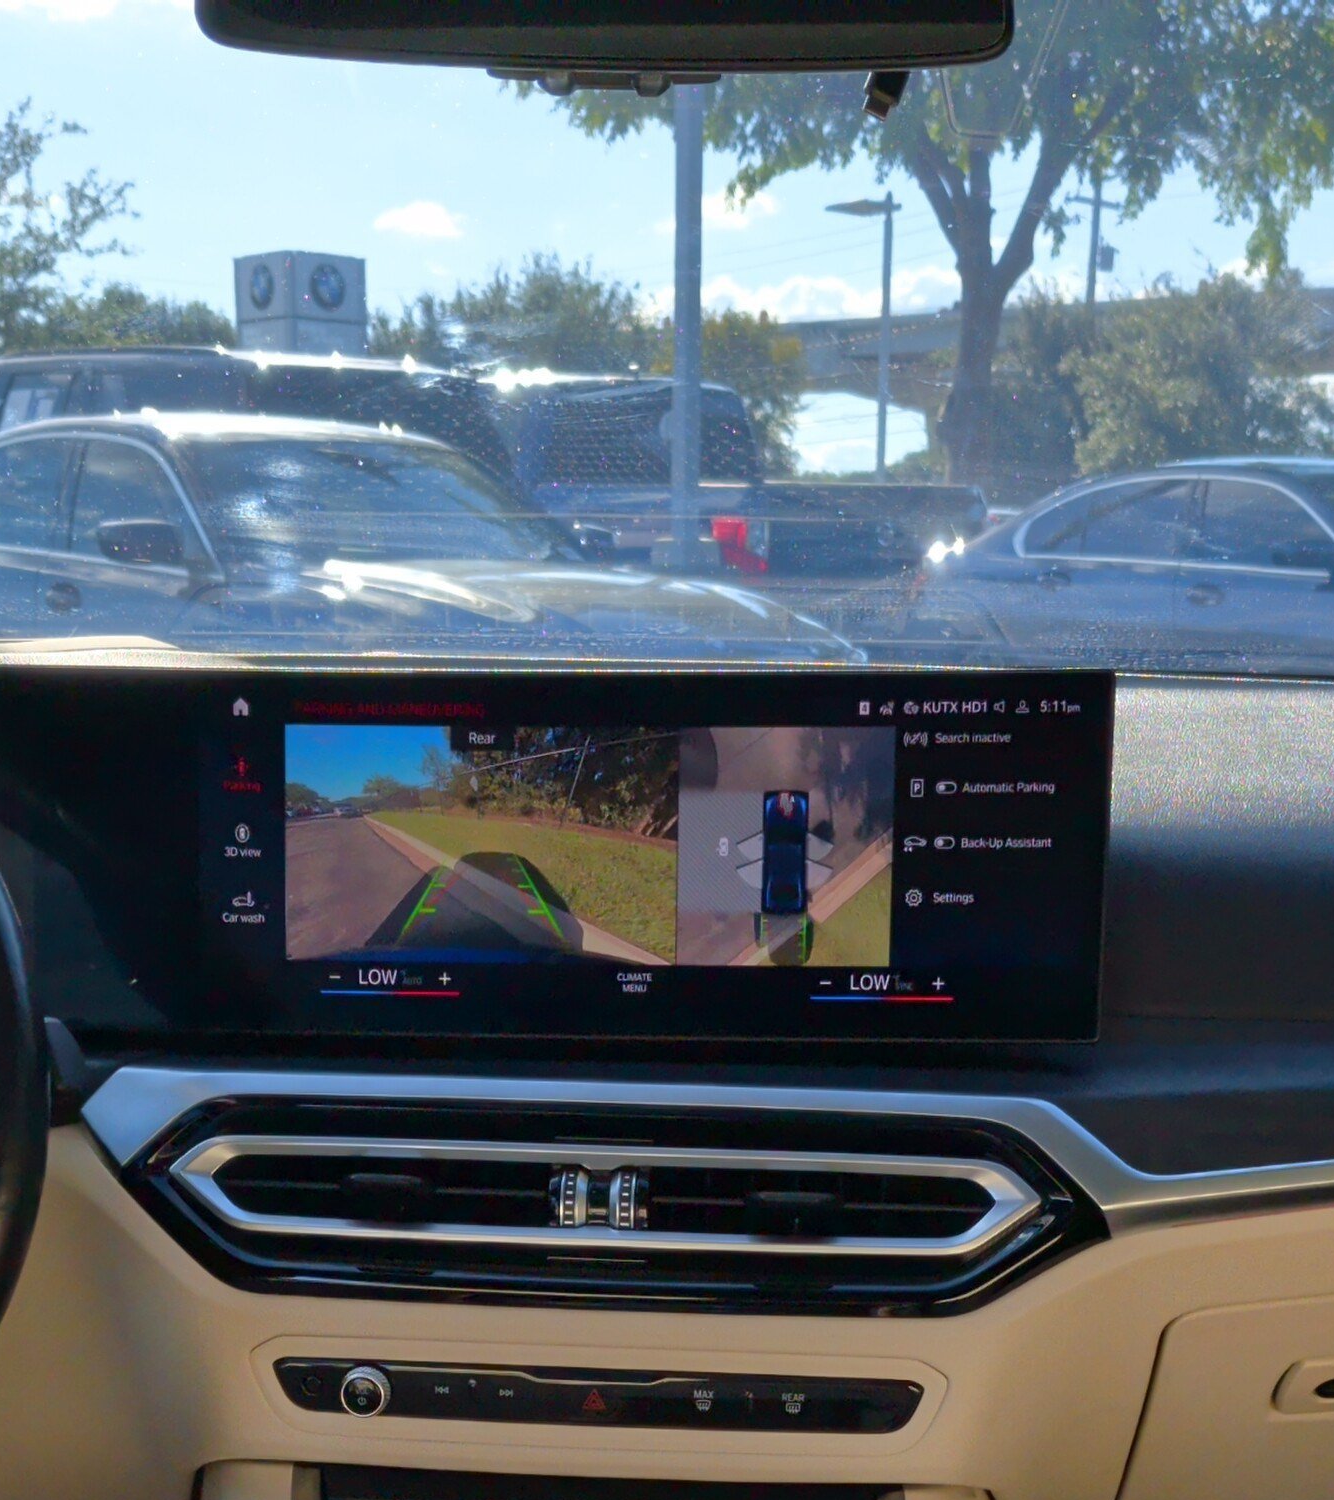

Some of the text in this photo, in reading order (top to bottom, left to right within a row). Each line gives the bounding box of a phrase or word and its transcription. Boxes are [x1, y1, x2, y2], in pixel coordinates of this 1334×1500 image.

[923, 701, 988, 713] KUTX HD1
[468, 731, 496, 745] Rear
[935, 732, 1012, 744] Search inactive
[962, 782, 1056, 795] Automatic Parking
[961, 837, 1052, 849] Back-Up Assistant
[224, 847, 262, 858] 3D view
[932, 892, 975, 905] Settings
[222, 912, 265, 923] Car wash
[358, 968, 398, 986] LOW
[616, 972, 652, 983] CLIMATE
[622, 984, 647, 994] MENU
[850, 975, 890, 992] LOW
[693, 1389, 715, 1400] MAX
[781, 1392, 806, 1402] REAR
